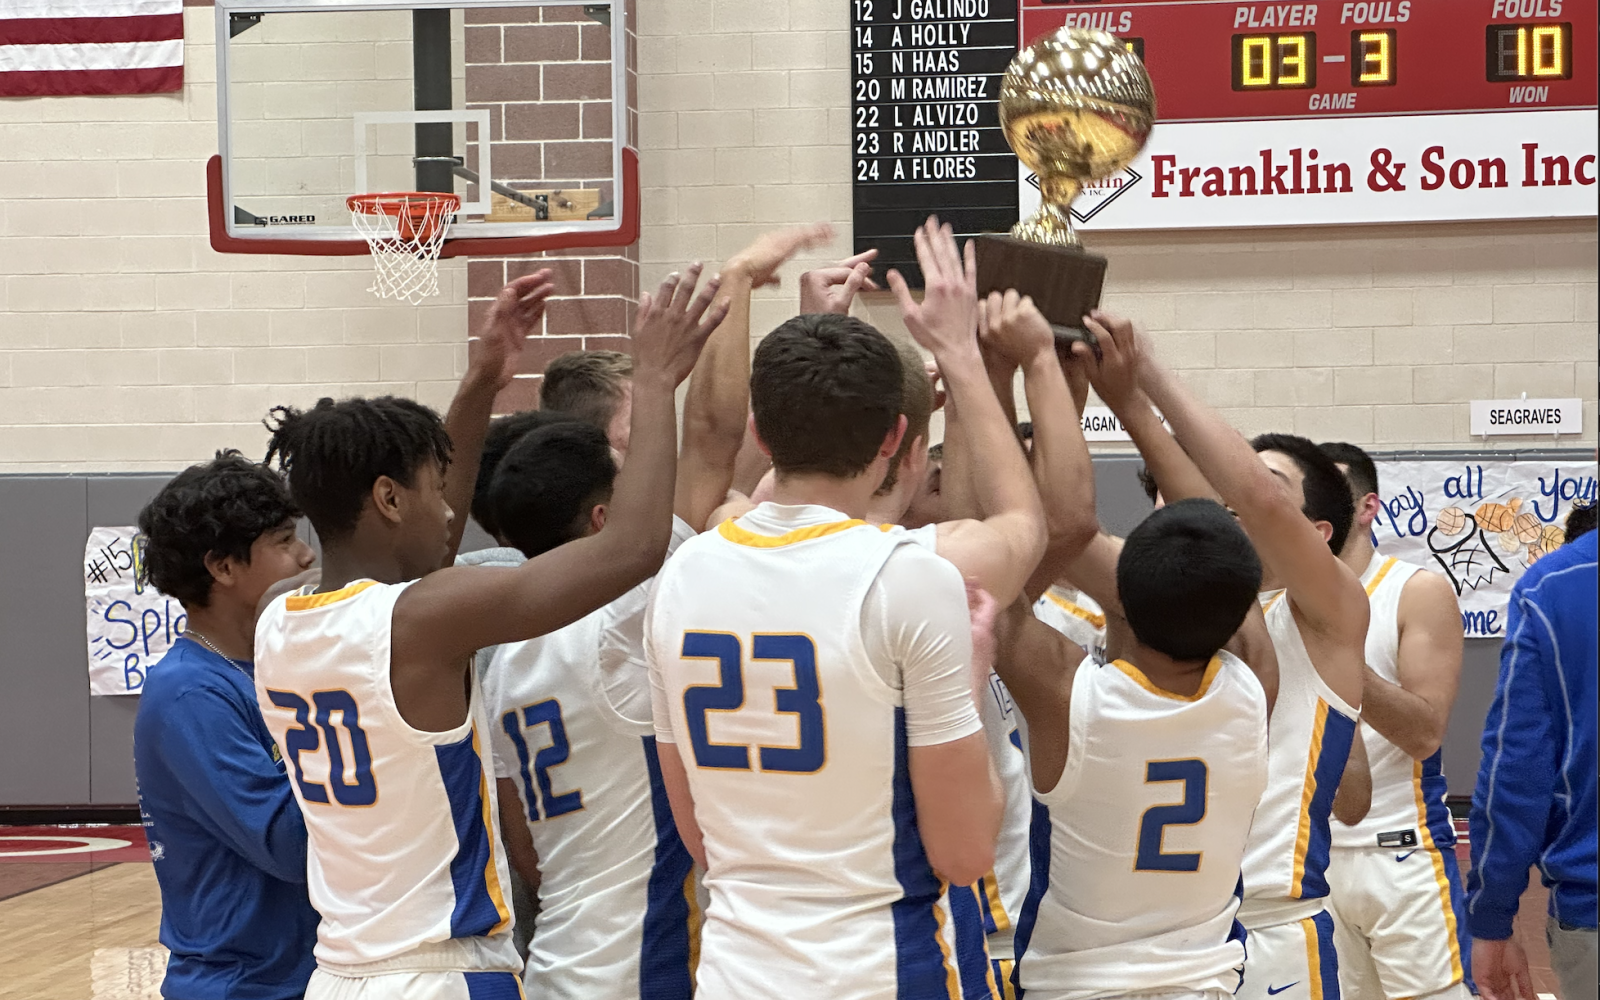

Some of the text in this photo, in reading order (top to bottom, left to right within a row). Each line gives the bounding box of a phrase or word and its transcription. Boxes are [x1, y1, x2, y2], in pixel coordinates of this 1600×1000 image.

[854, 0, 989, 21] 12 J GALINDO
[1064, 11, 1132, 33] FOULS
[1233, 2, 1411, 28] PLAYER FOULS
[1492, 0, 1562, 19] FOULS
[855, 23, 971, 48] 14 A HOLLY
[855, 50, 960, 75] 15 N HAAS
[1242, 36, 1312, 86] 03
[1359, 33, 1390, 82] 3
[1517, 26, 1562, 76] 10
[856, 76, 987, 101] 20 M RAMIREZ
[1509, 86, 1549, 103] WON
[1308, 93, 1357, 110] GAME
[856, 103, 979, 128] 22 L ALVIZO
[857, 130, 980, 154] 23 R ANDLER
[857, 156, 976, 181] 24 A FLORES
[1151, 142, 1596, 198] Franklin & Son Inc
[269, 215, 316, 223] GARED
[1489, 408, 1562, 425] SEAGRAVES
[1443, 465, 1483, 499] all
[87, 537, 133, 583] #15
[680, 629, 829, 776] 23
[266, 688, 379, 808] 20
[502, 697, 586, 823] 12
[1132, 757, 1210, 873] 2
[1404, 834, 1412, 842] S
